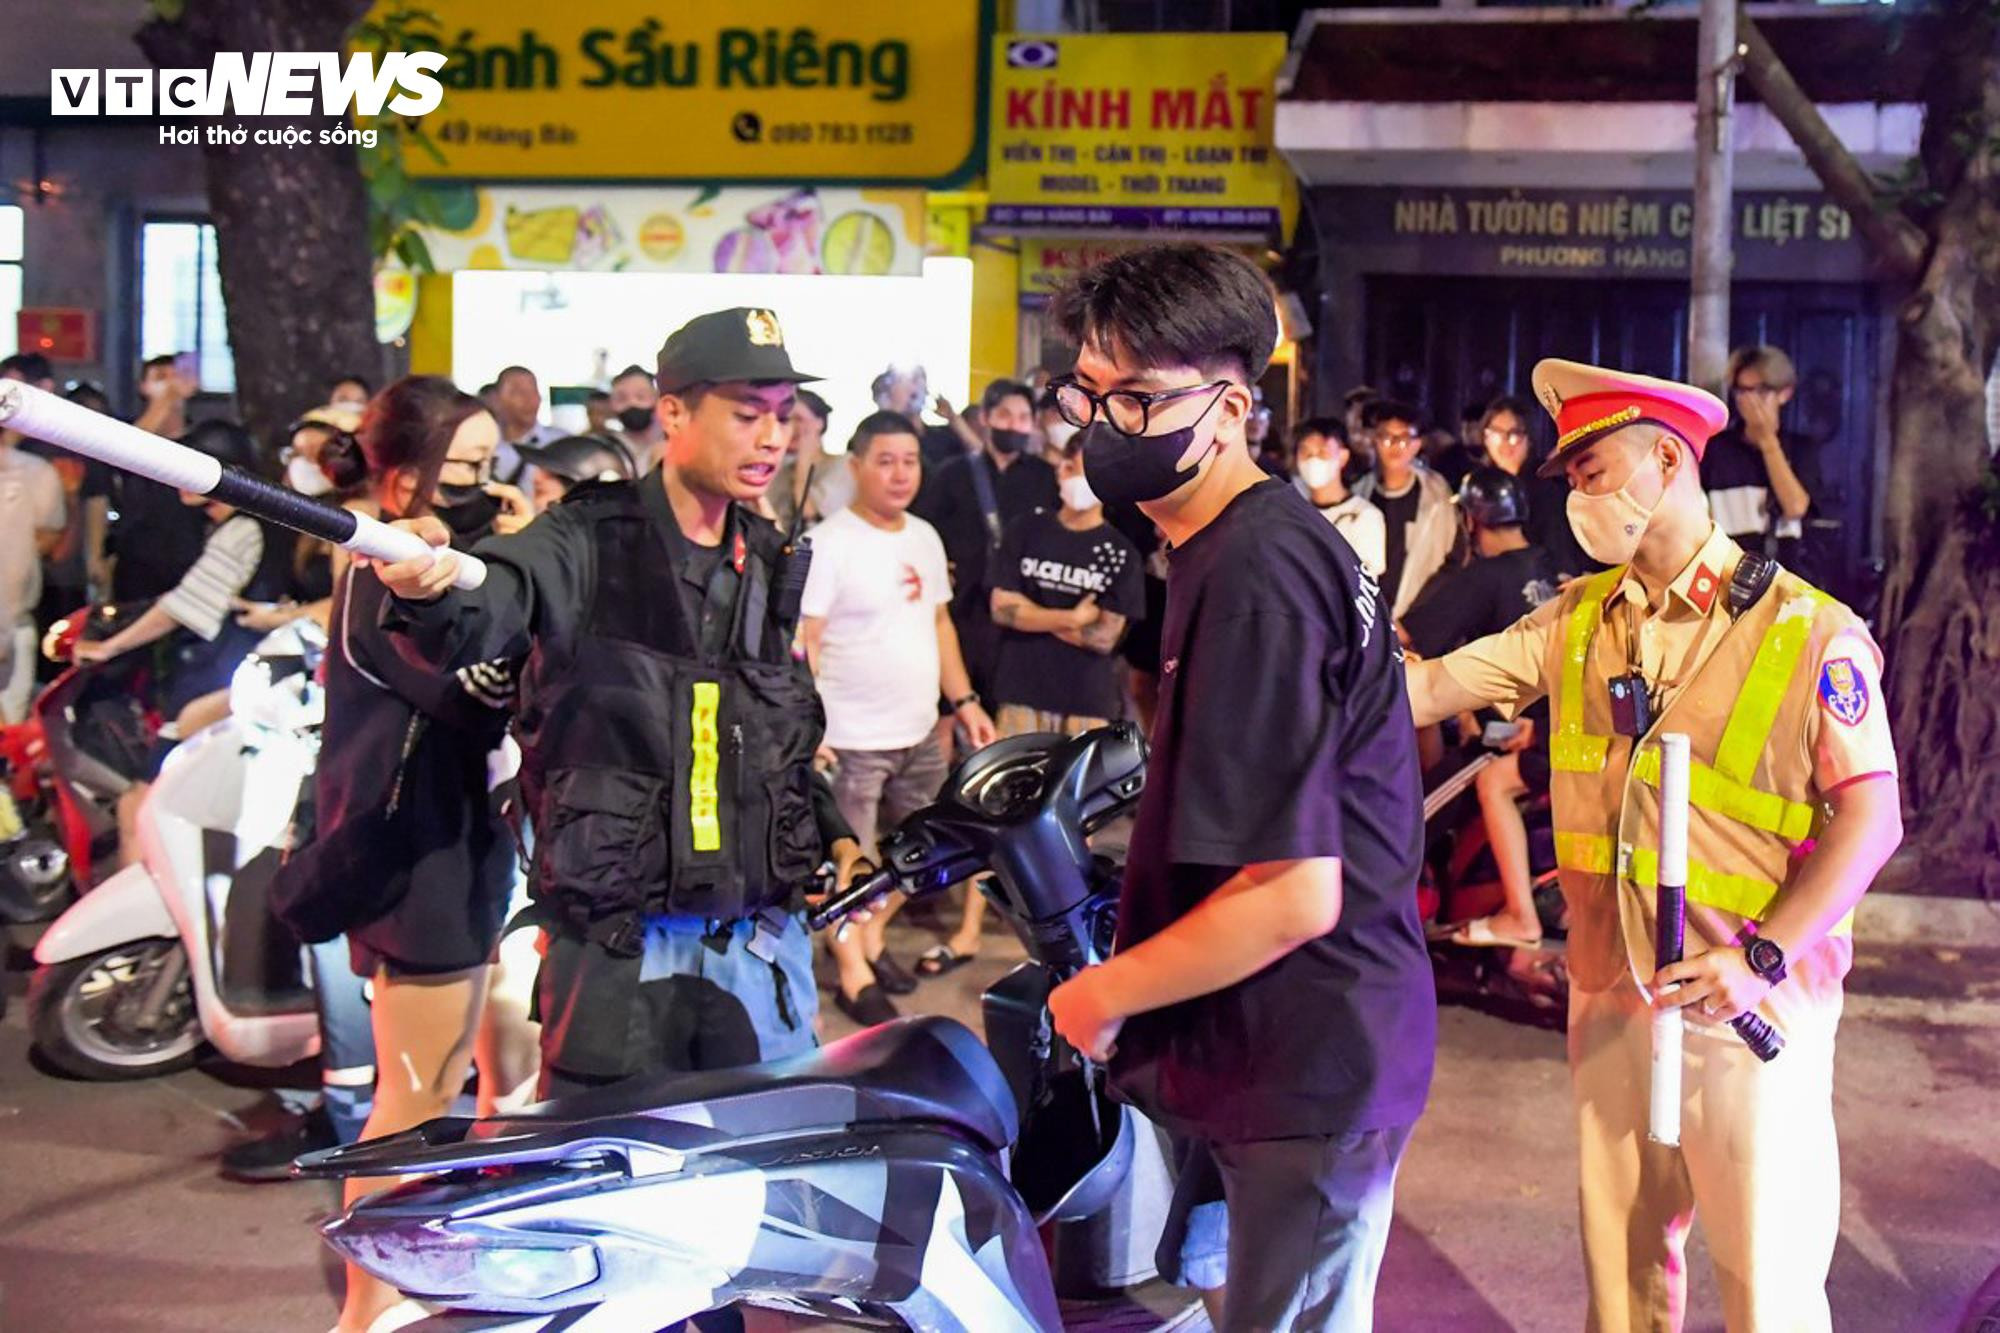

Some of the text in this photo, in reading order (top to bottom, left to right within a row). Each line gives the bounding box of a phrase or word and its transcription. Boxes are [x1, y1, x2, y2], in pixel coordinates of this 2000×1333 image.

[404, 29, 560, 90] ánh
[718, 28, 909, 100] Riêng
[1006, 79, 1130, 130] KÍNH
[1394, 195, 1457, 233] NHÀ
